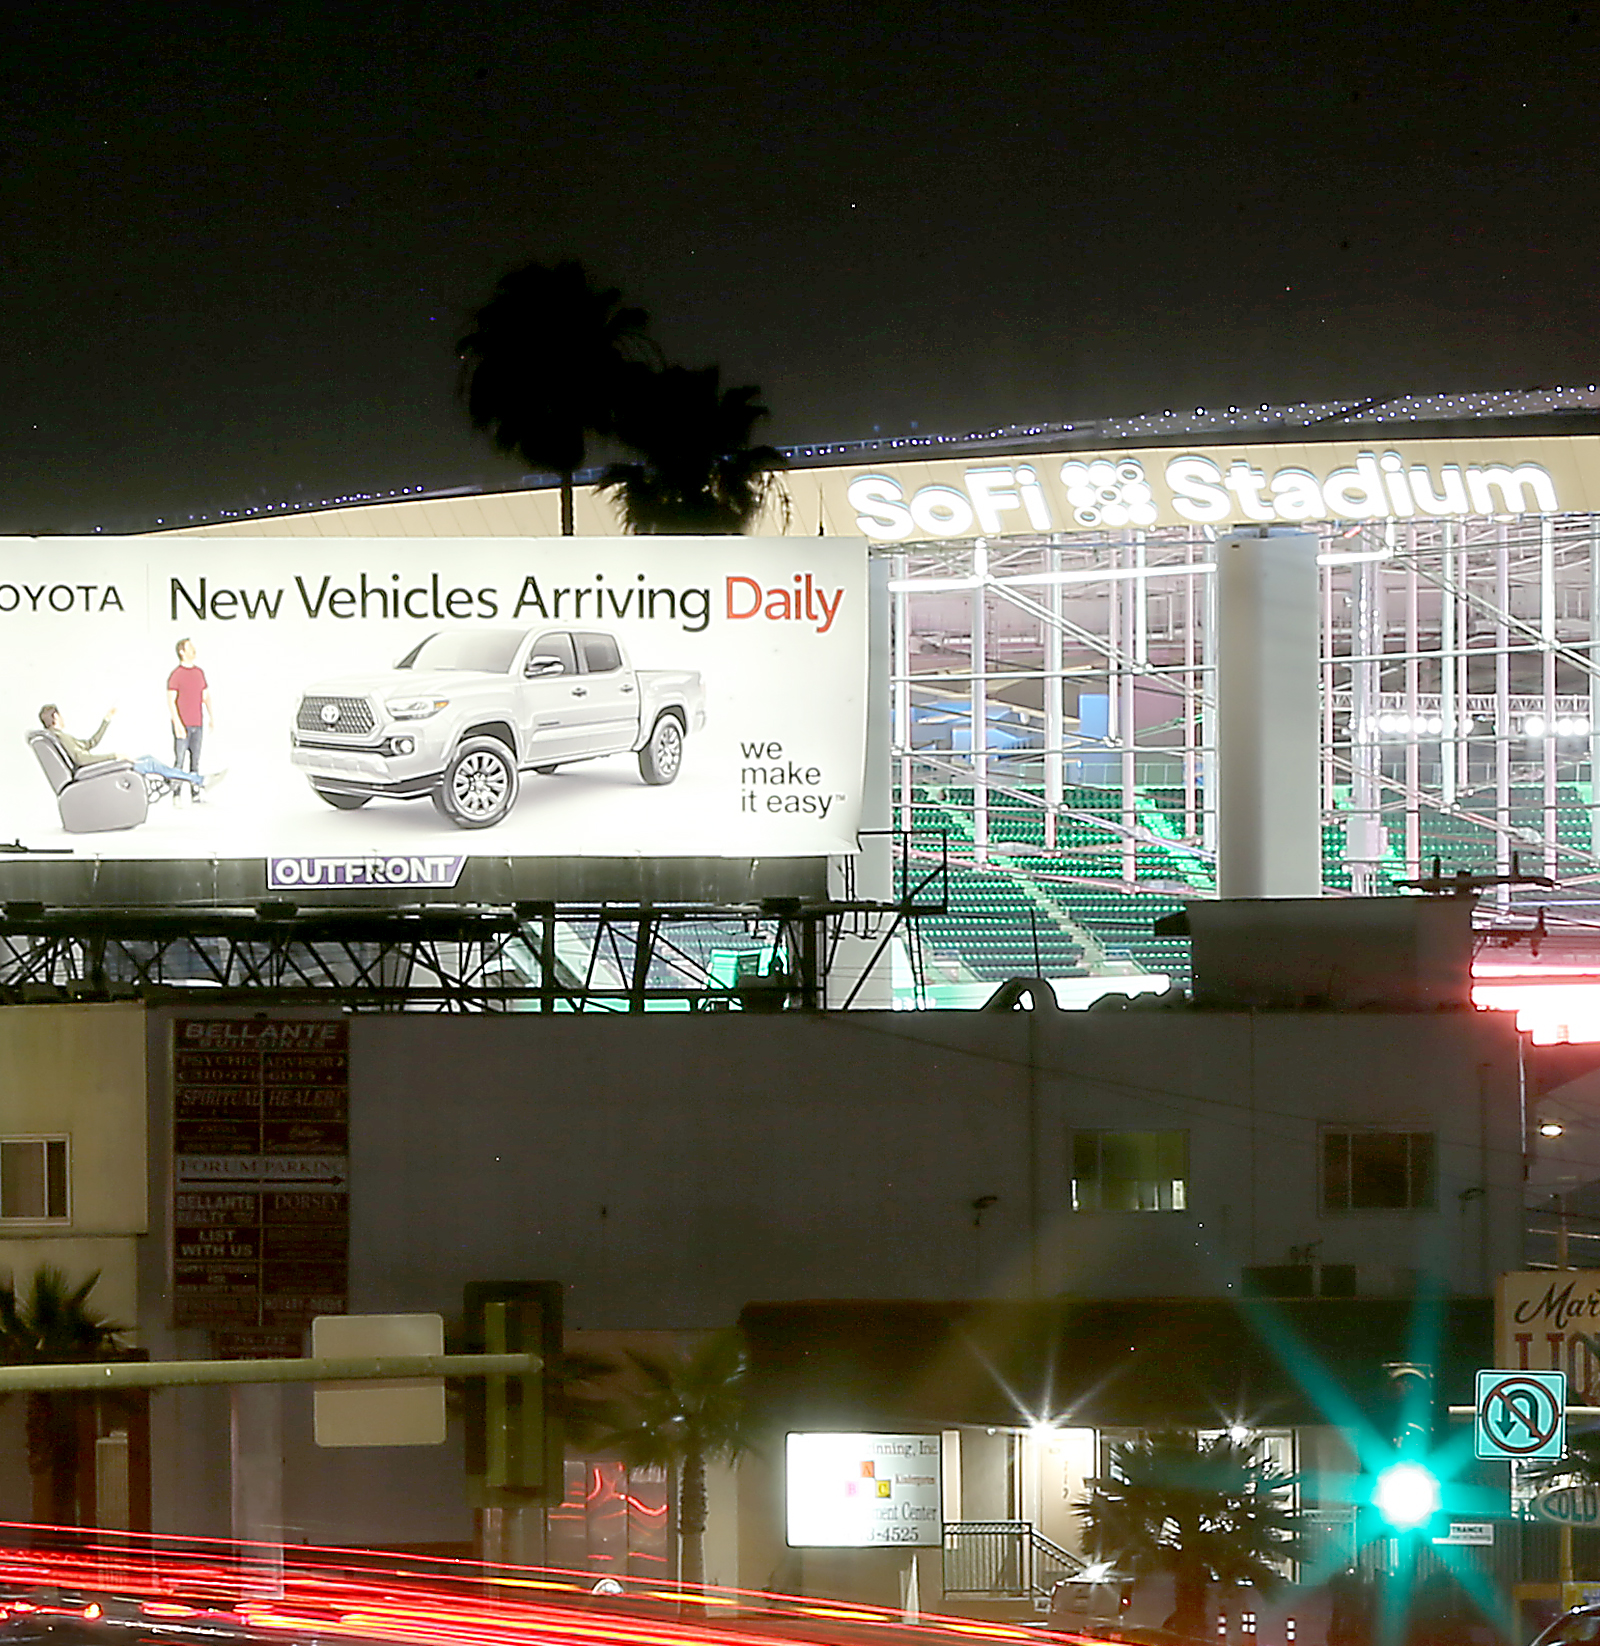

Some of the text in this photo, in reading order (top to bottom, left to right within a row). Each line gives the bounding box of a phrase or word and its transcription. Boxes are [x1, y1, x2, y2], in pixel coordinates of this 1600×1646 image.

[848, 450, 1560, 541] SoFi Stadium
[169, 573, 845, 633] New Vehicles Arriving Daily
[740, 741, 783, 760] we
[741, 760, 821, 785] make
[741, 788, 757, 813] it
[275, 857, 456, 885] OUTFRONT
[185, 1023, 340, 1040] BELLANTE
[180, 1161, 257, 1173] FORUM
[176, 1195, 255, 1210] BELLANTE
[198, 1230, 236, 1242] LIST
[180, 1244, 254, 1257] WITH US
[1452, 1526, 1483, 1534] TRANCE
